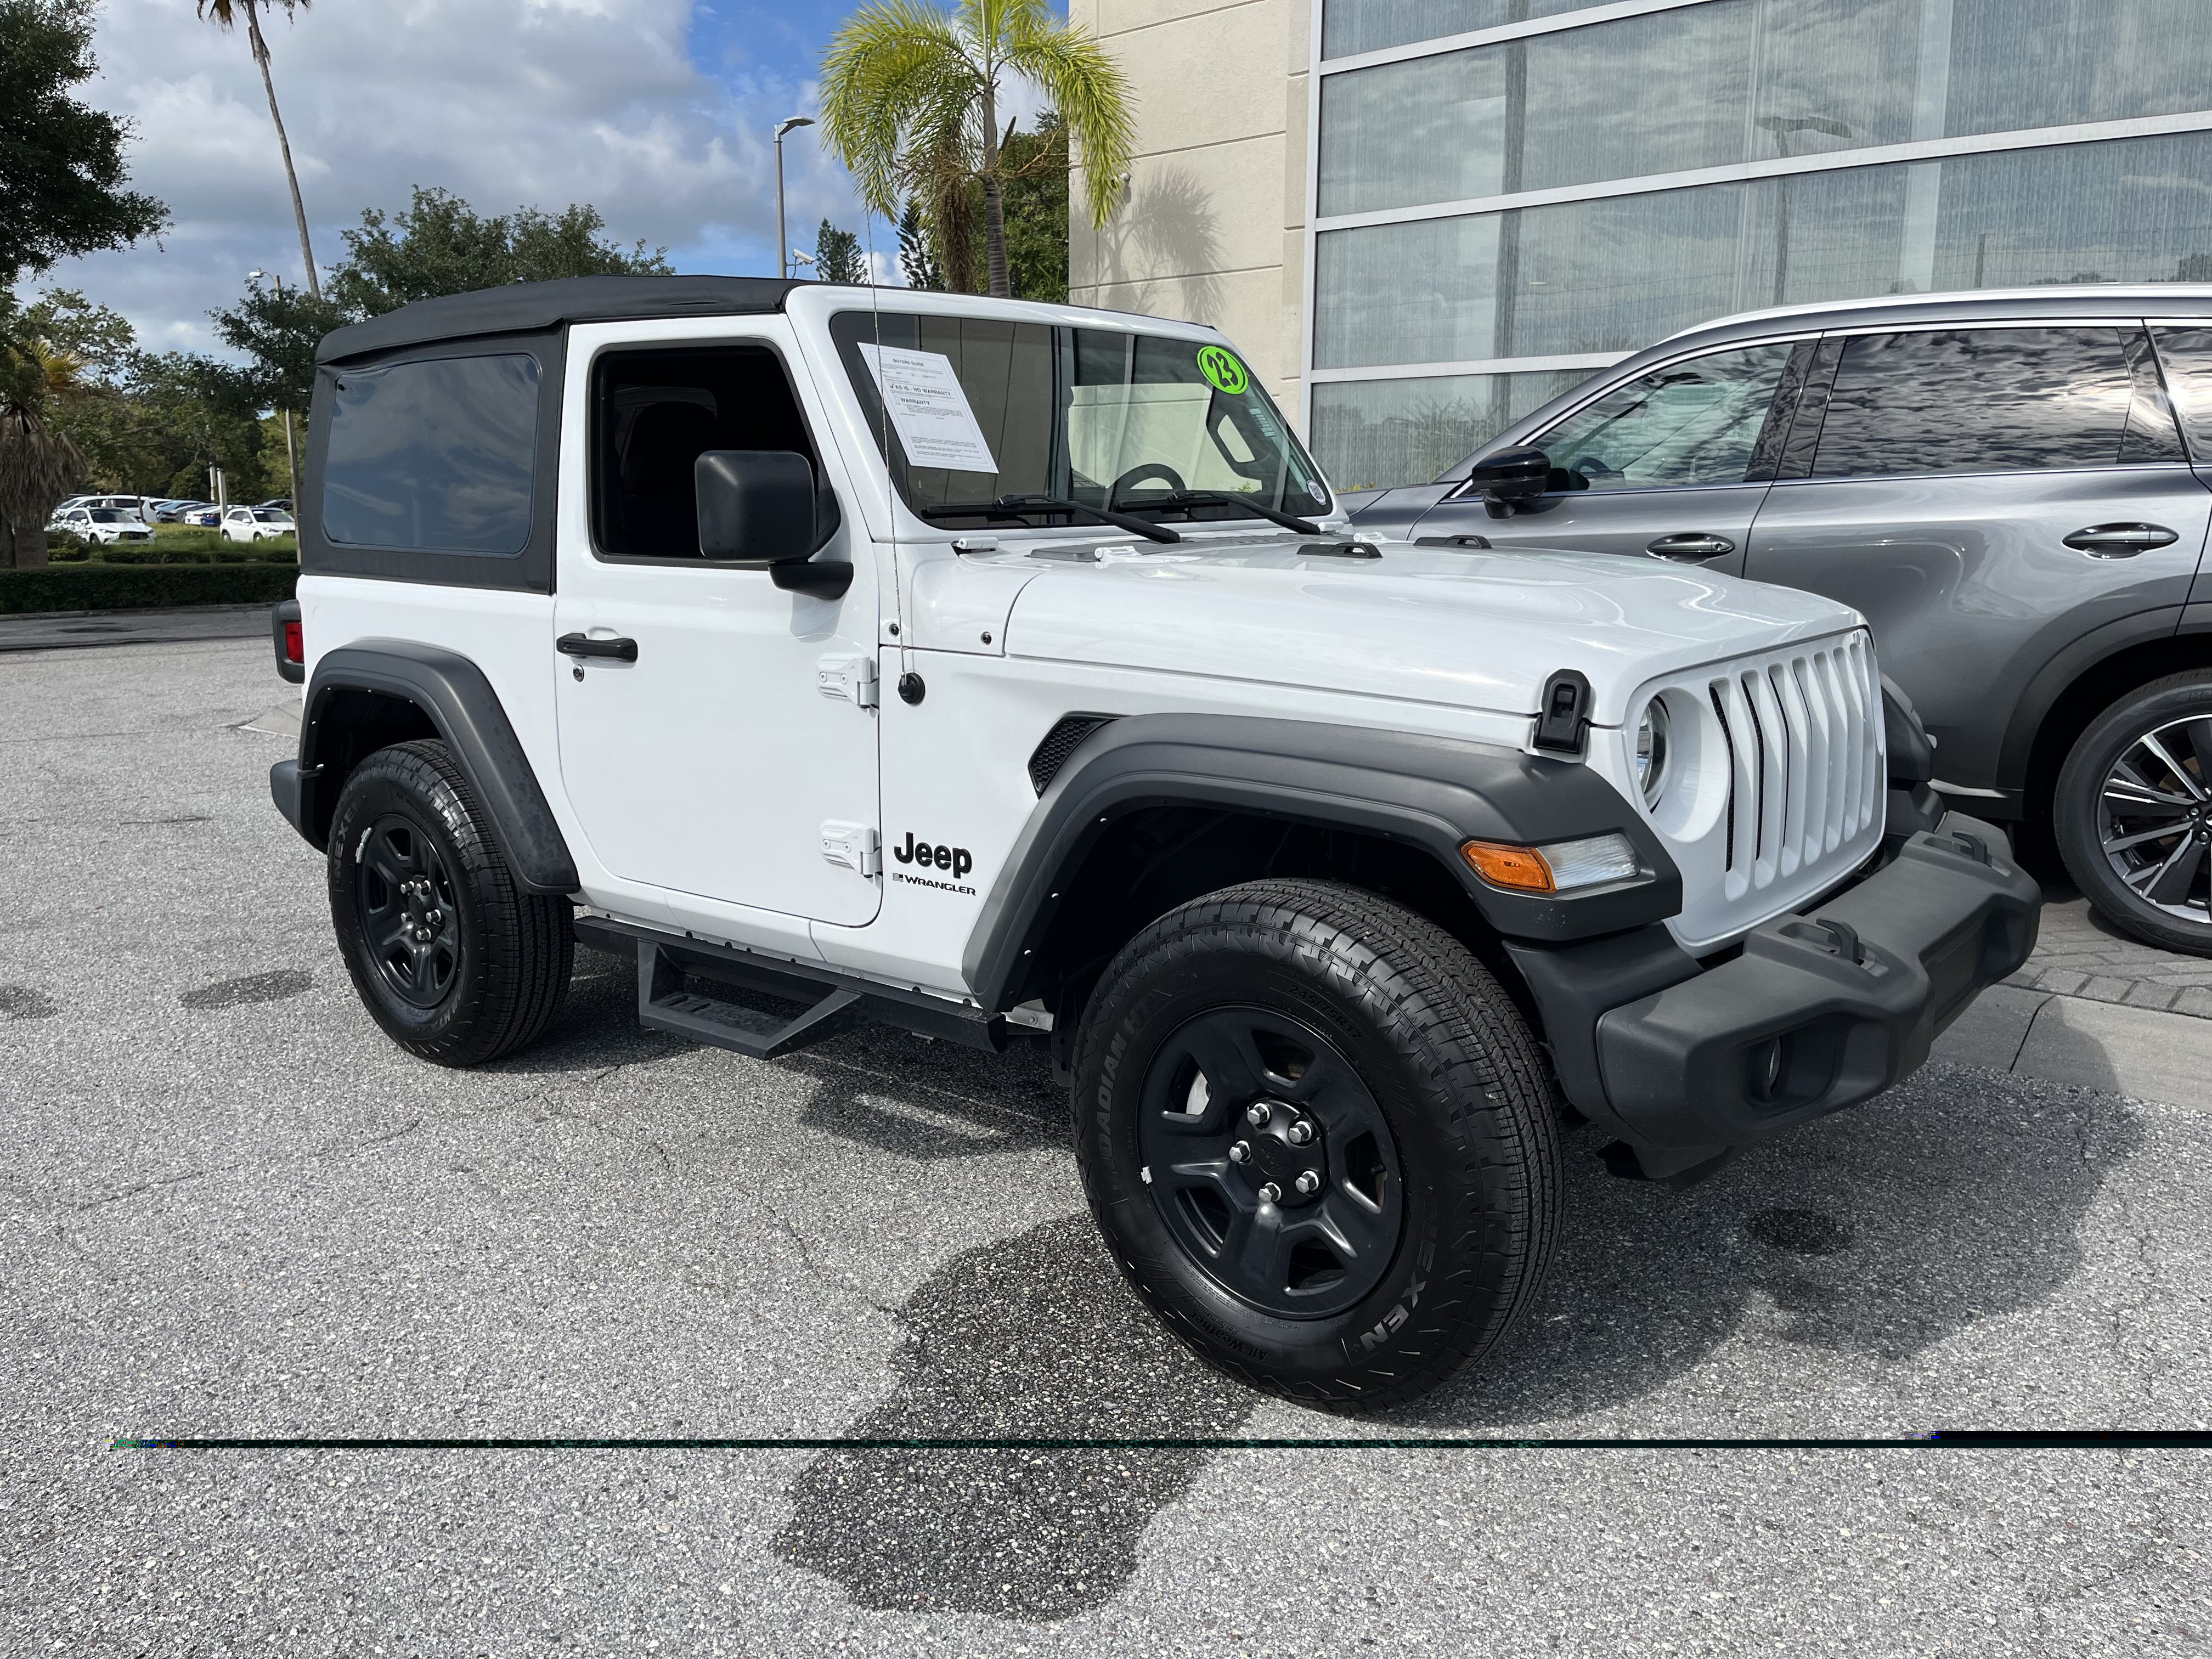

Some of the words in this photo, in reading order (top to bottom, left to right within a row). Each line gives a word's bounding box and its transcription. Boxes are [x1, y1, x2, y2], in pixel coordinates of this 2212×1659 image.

[1206, 352, 1238, 388] 23
[894, 832, 972, 879] Jeep
[904, 874, 977, 896] WRANGLER
[1289, 984, 1363, 1039] 245/75R17
[1189, 1312, 1269, 1361] All-Weather
